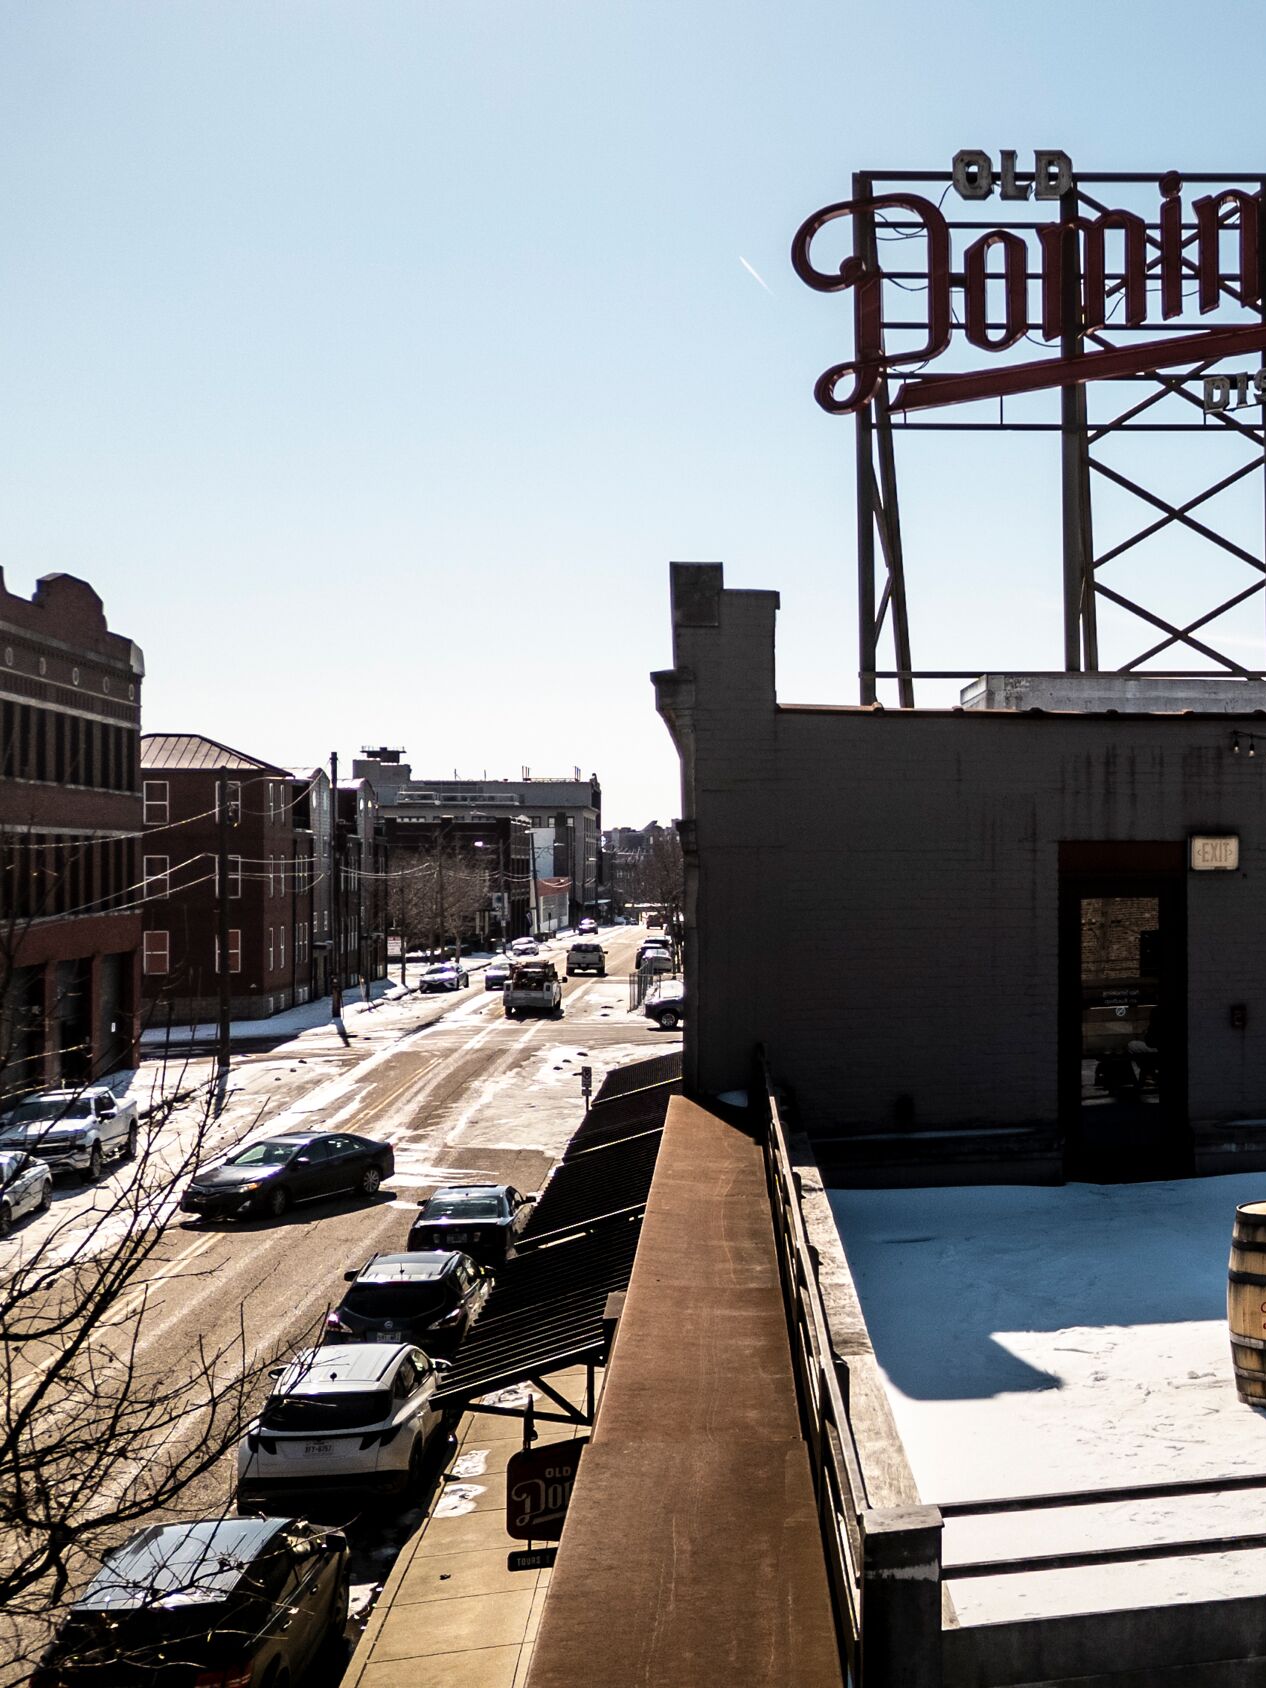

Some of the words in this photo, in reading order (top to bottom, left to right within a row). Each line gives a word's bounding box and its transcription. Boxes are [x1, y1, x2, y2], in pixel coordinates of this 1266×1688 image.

[952, 149, 1073, 201] OLD
[1202, 842, 1230, 862] EXIT
[545, 1466, 572, 1478] OLD
[517, 1556, 541, 1567] TOURS
